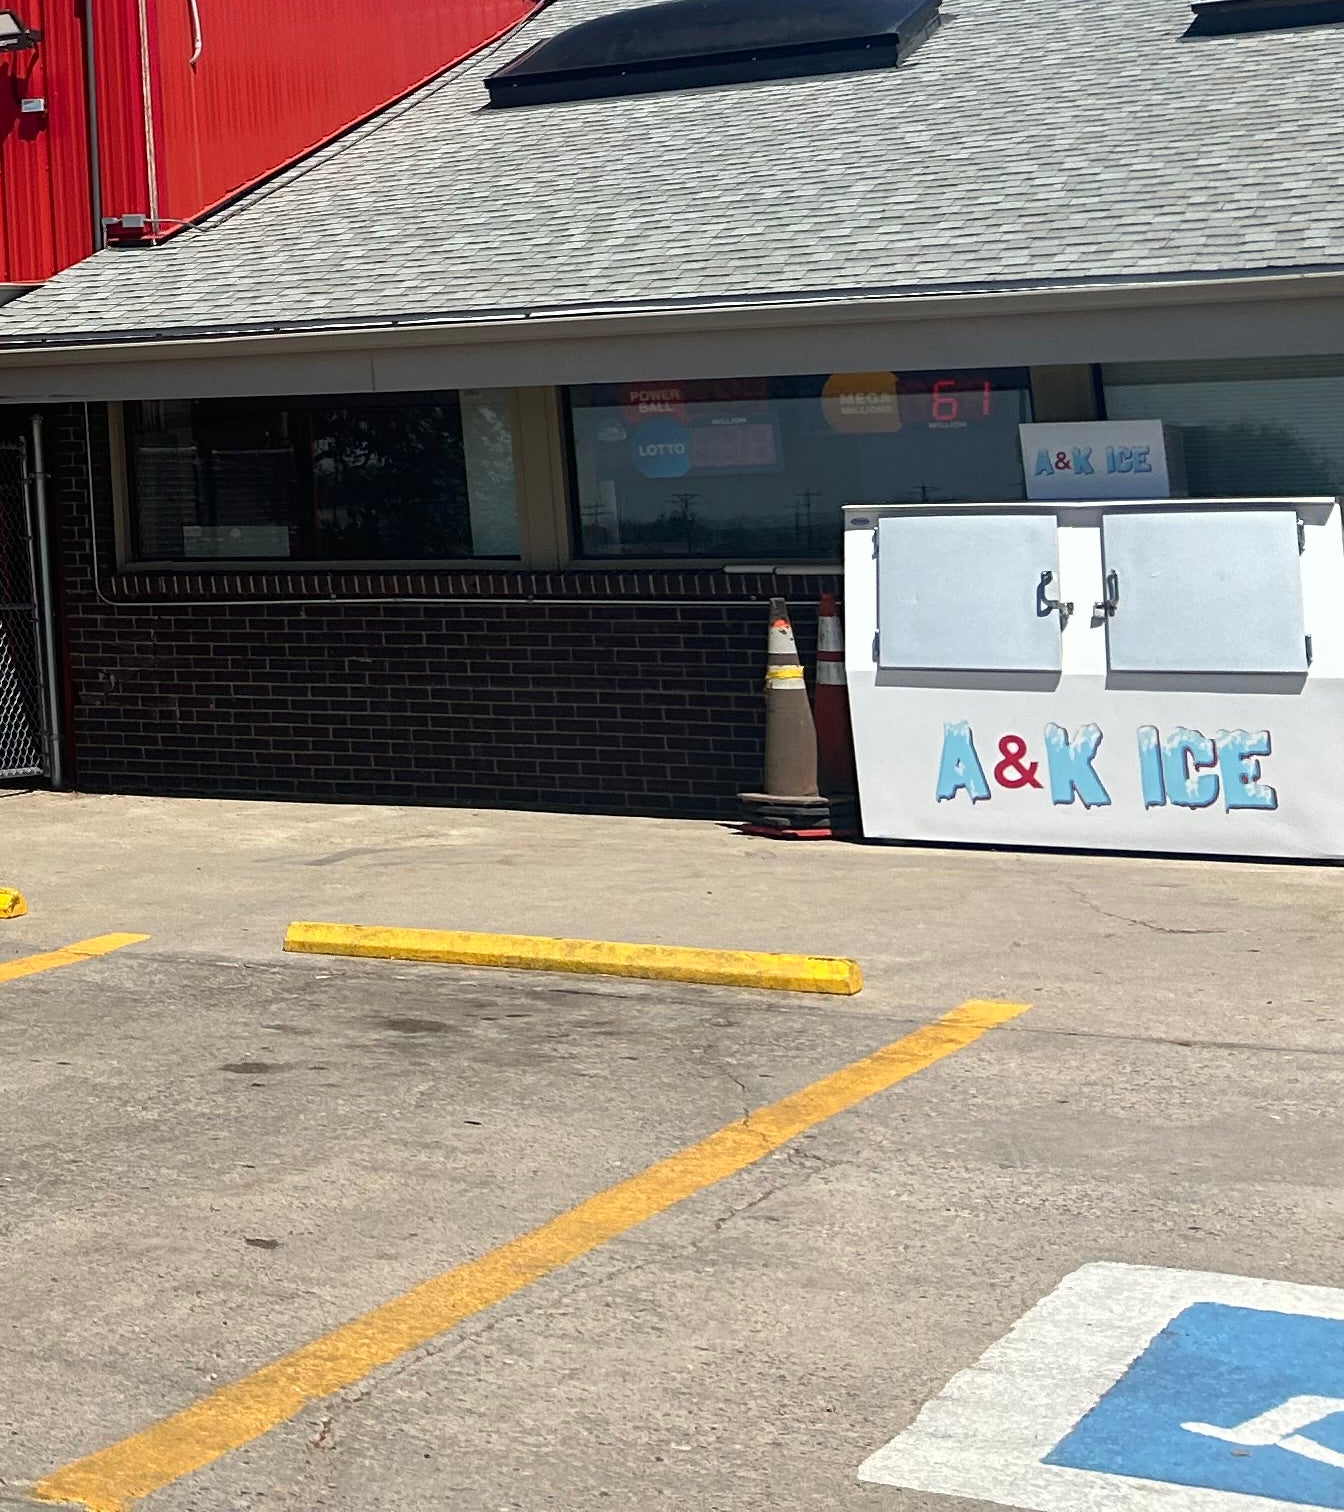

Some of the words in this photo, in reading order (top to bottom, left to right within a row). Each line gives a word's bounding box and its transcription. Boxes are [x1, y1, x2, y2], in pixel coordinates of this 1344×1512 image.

[630, 389, 681, 402] POWER
[839, 392, 892, 406] MEGA
[638, 402, 673, 413] BALL
[638, 444, 685, 457] LOTTO
[1035, 446, 1095, 476] A&K
[1105, 445, 1152, 474] ICE
[936, 719, 1112, 810] A&K
[1137, 724, 1278, 814] ICE
